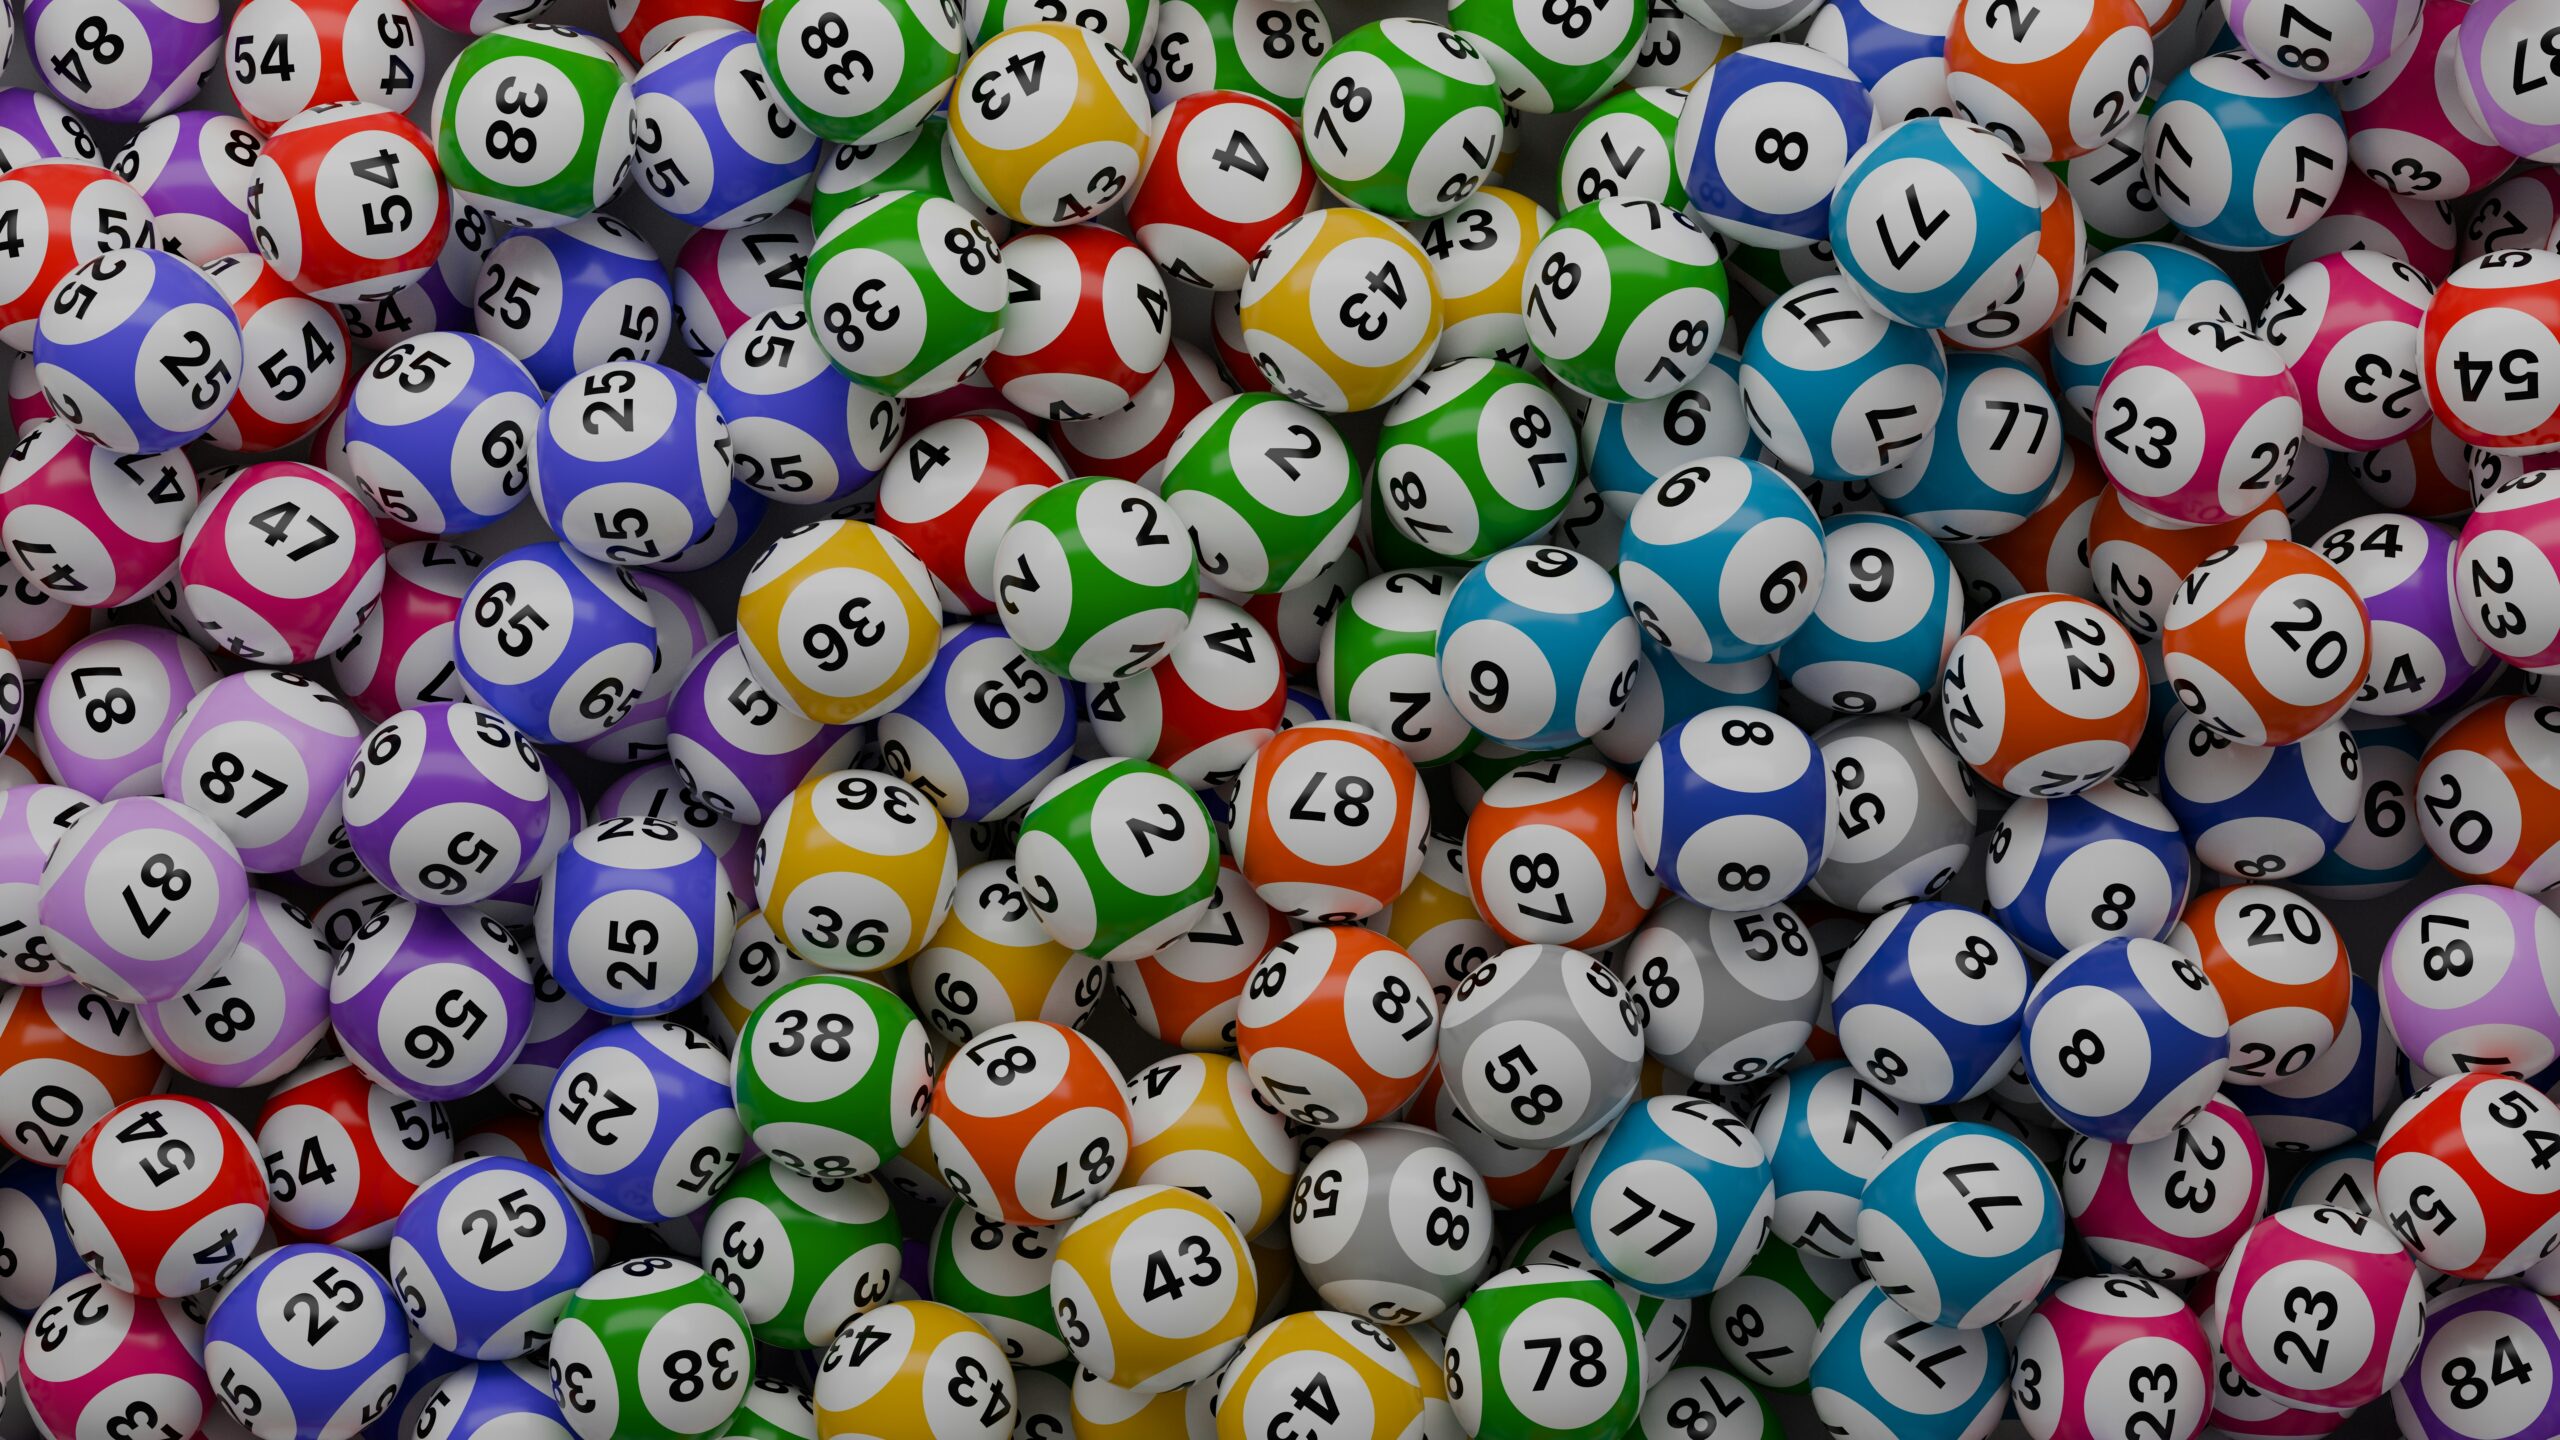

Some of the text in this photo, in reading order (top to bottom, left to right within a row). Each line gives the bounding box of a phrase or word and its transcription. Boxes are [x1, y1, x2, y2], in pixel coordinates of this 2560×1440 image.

[51, 16, 124, 93] 84
[235, 35, 294, 84] 54
[378, 14, 414, 95] 54
[802, 13, 873, 95] 38
[1257, 9, 1324, 59] 38
[2277, 4, 2332, 72] 87
[972, 51, 1046, 120] 43
[1315, 77, 1371, 156] 78
[2094, 55, 2150, 137] 20
[486, 76, 548, 163] 38
[1755, 128, 1808, 171] 8
[637, 117, 689, 197] 25
[1213, 130, 1269, 181] 4
[2155, 123, 2193, 206] 77
[2287, 146, 2334, 219] 77
[351, 149, 413, 235] 54
[1053, 166, 1126, 222] 43
[1422, 210, 1498, 259] 43
[1877, 184, 1950, 270] 77
[54, 255, 126, 320] 25
[742, 233, 809, 292] 47
[1160, 257, 1213, 289] 4
[1527, 252, 1580, 337] 78
[477, 263, 540, 329] 25
[824, 279, 900, 352] 38
[1137, 284, 1167, 334] 4
[1340, 261, 1408, 340] 43
[1783, 288, 1863, 348] 77
[2067, 267, 2118, 337] 77
[160, 331, 231, 409] 25
[258, 321, 335, 401] 54
[373, 344, 451, 392] 65
[1645, 320, 1709, 386] 78
[2345, 354, 2421, 418] 23
[2454, 349, 2538, 401] 54
[583, 369, 635, 435] 25
[1663, 390, 1710, 445] 6
[1985, 401, 2048, 454] 77
[2105, 398, 2177, 468] 23
[114, 453, 186, 504] 47
[482, 421, 529, 496] 65
[734, 452, 813, 492] 25
[910, 439, 950, 483] 4
[1265, 425, 1321, 481] 2
[1510, 405, 1567, 488] 78
[248, 501, 339, 561] 47
[594, 508, 660, 562] 25
[1122, 498, 1169, 546] 2
[1390, 472, 1453, 543] 78
[12, 540, 88, 592] 47
[2323, 523, 2402, 565] 84
[999, 554, 1041, 614] 2
[1387, 573, 1443, 595] 2
[2472, 557, 2526, 638] 23
[475, 582, 549, 657] 65
[803, 597, 885, 672] 36
[1204, 623, 1255, 663] 4
[2271, 598, 2348, 678] 20
[2055, 618, 2115, 688] 22
[71, 667, 135, 733] 87
[974, 655, 1049, 729] 65
[1390, 692, 1431, 742] 2
[476, 712, 540, 772] 56
[1722, 720, 1773, 746] 8
[2339, 730, 2358, 781] 8
[200, 752, 288, 818] 87
[837, 777, 919, 825] 36
[1290, 772, 1374, 827] 87
[2364, 780, 2405, 837] 6
[2424, 774, 2492, 854] 20
[419, 832, 498, 895] 56
[1125, 804, 1185, 857] 2
[123, 853, 191, 939] 87
[1510, 853, 1573, 924] 87
[1718, 863, 1770, 892] 8
[2234, 854, 2286, 879] 8
[802, 906, 888, 957] 36
[1733, 912, 1808, 961] 58
[2092, 884, 2135, 931] 8
[2239, 904, 2321, 945] 20
[607, 920, 658, 990] 25
[1956, 936, 1998, 979] 8
[2172, 960, 2208, 990] 8
[2421, 915, 2473, 981] 87
[405, 990, 487, 1068] 56
[769, 1010, 853, 1062] 38
[1373, 976, 1433, 1041] 87
[966, 1034, 1037, 1086] 87
[1485, 1045, 1562, 1125] 58
[1867, 1048, 1908, 1085] 8
[2059, 1029, 2104, 1078] 8
[2229, 1043, 2315, 1077] 20
[16, 1085, 83, 1157] 20
[559, 1073, 636, 1145] 25
[1262, 1077, 1338, 1126] 87
[2489, 1090, 2560, 1171] 54
[116, 1110, 195, 1187] 54
[263, 1136, 337, 1202] 54
[1051, 1137, 1116, 1208] 87
[2165, 1127, 2225, 1213] 23
[462, 1189, 545, 1264] 25
[1294, 1170, 1342, 1224] 58
[1427, 1167, 1473, 1250] 58
[1610, 1187, 1695, 1257] 77
[1943, 1163, 2022, 1232] 77
[2390, 1186, 2456, 1253] 54
[1143, 1236, 1221, 1302] 43
[36, 1283, 108, 1351] 23
[284, 1267, 363, 1346] 25
[1725, 1303, 1794, 1376] 78
[2274, 1287, 2337, 1373] 23
[663, 1338, 738, 1402] 38
[1524, 1335, 1606, 1391] 78
[1885, 1321, 1967, 1389] 77
[2442, 1336, 2532, 1409] 84
[948, 1356, 1012, 1428] 43
[2125, 1364, 2177, 1440] 23
